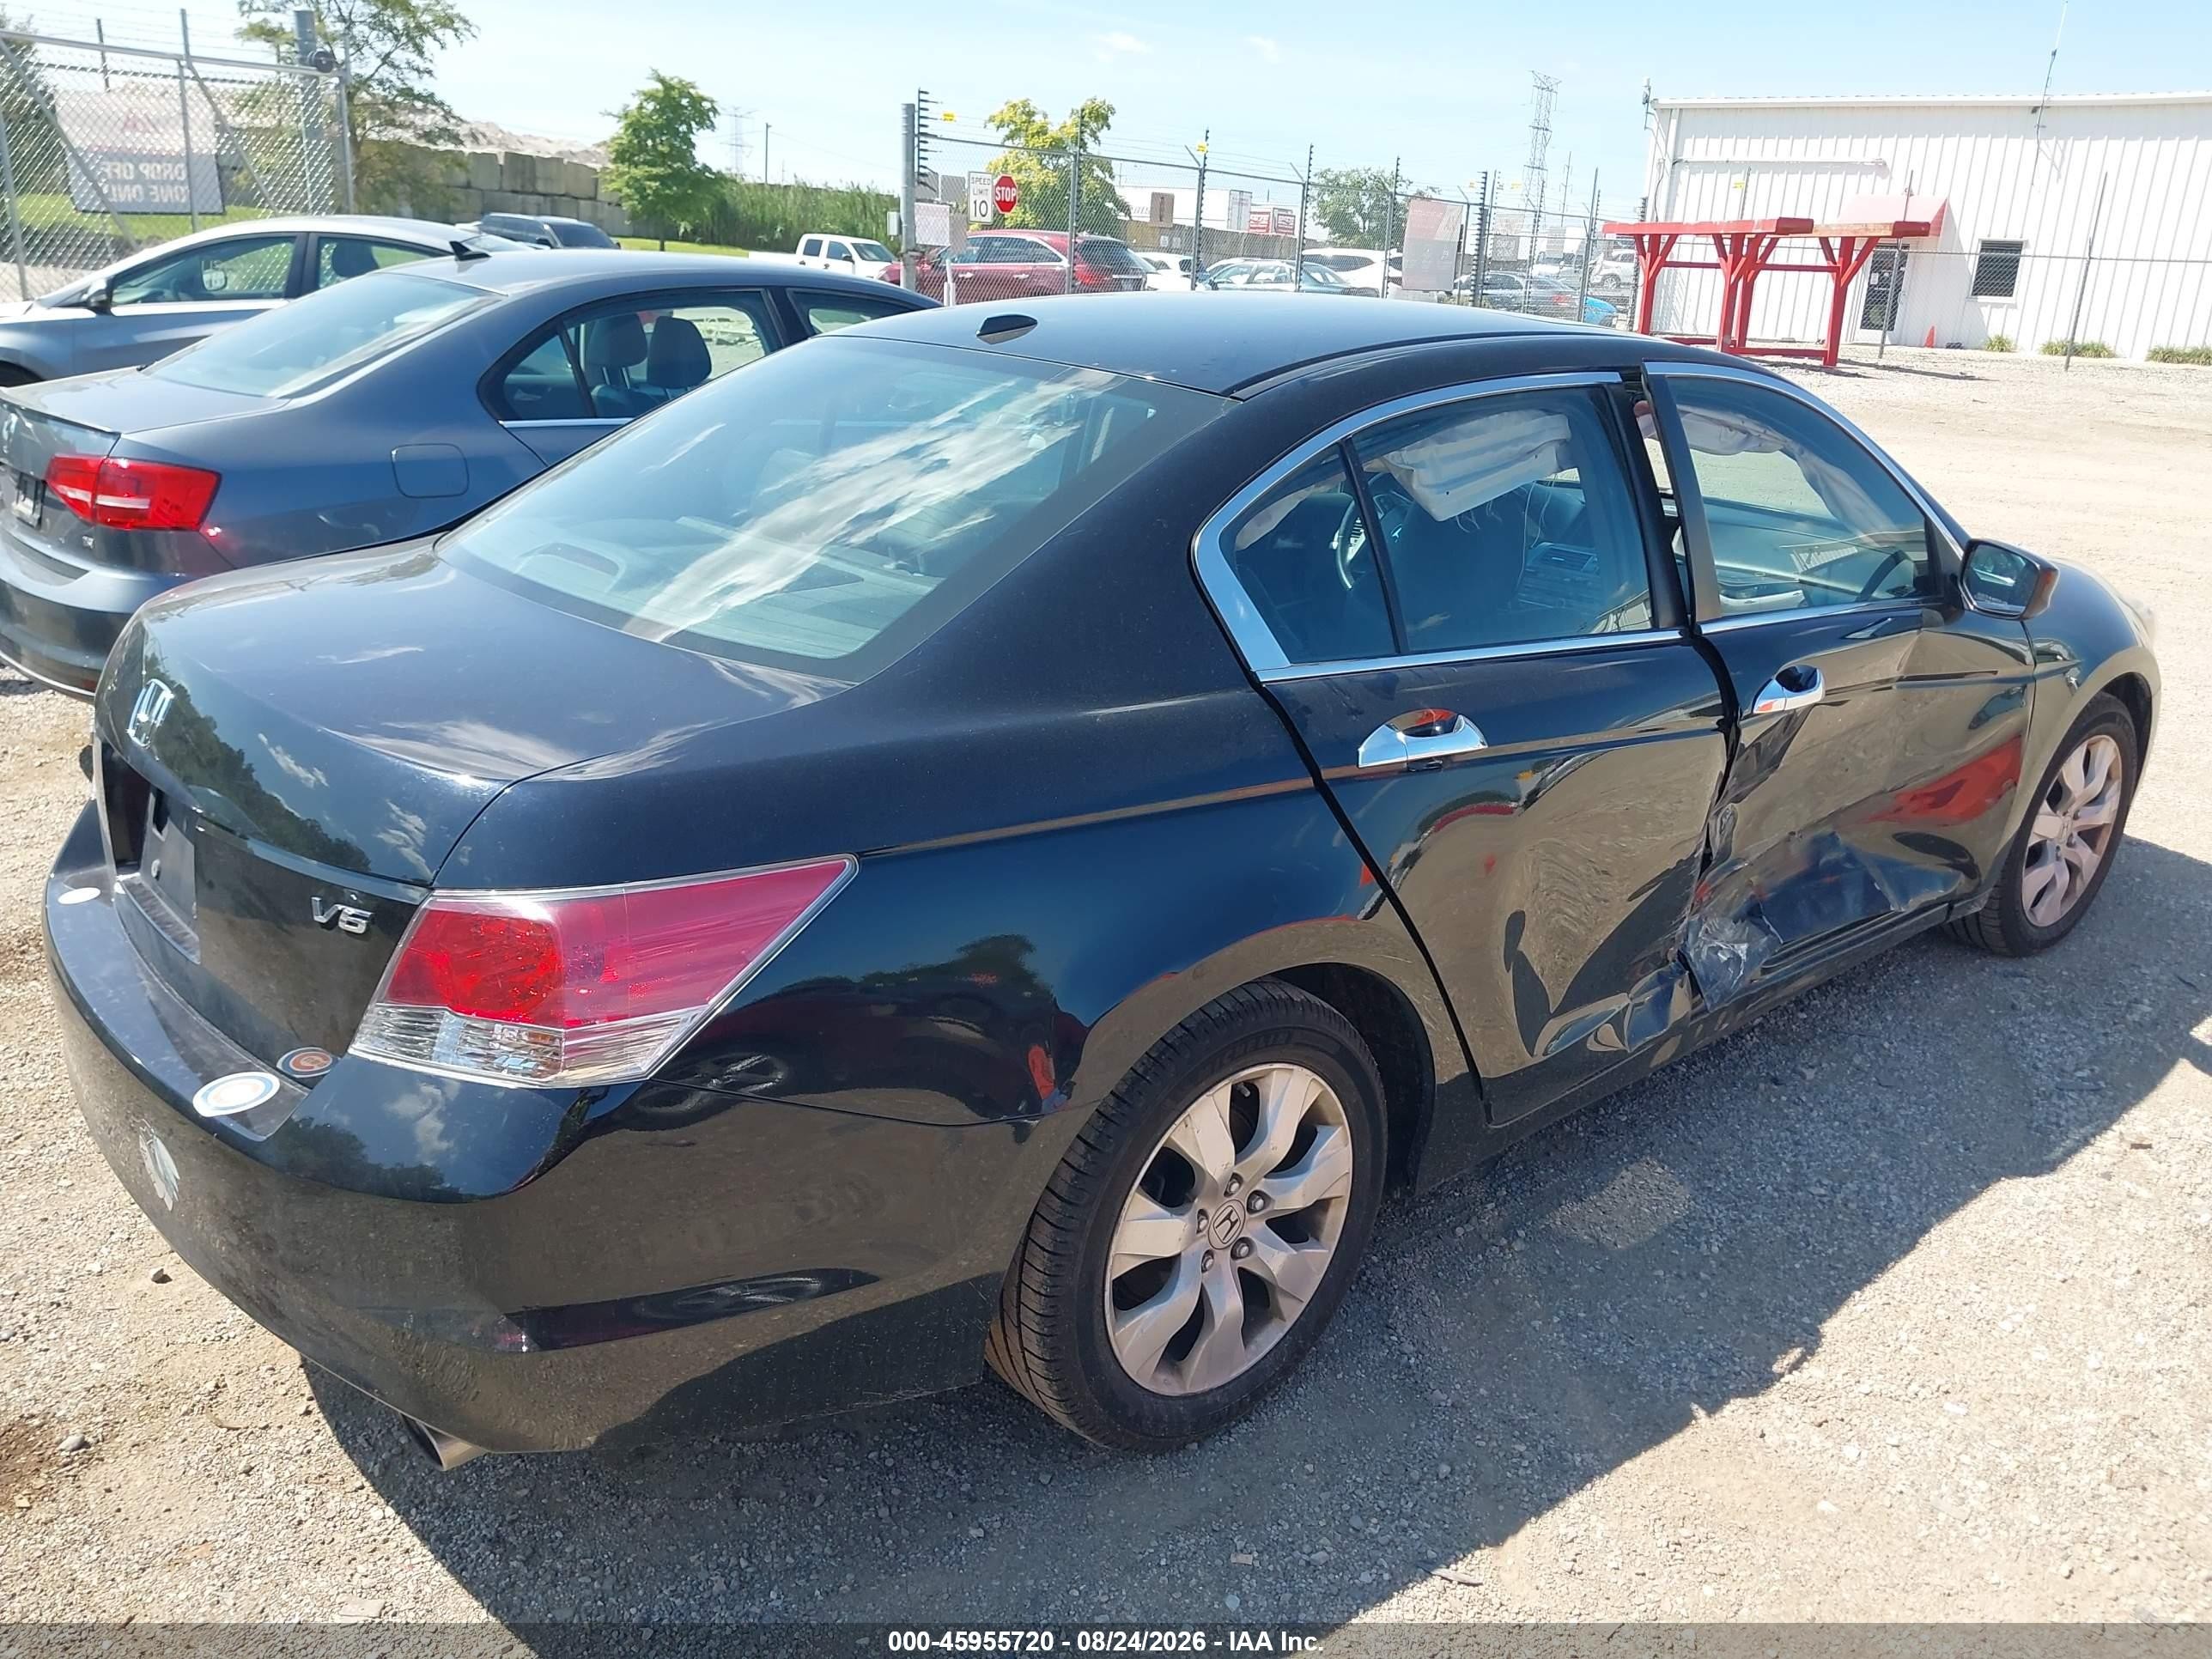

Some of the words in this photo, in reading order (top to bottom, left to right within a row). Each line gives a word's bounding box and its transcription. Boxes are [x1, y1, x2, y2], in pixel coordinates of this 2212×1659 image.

[971, 176, 991, 185] SPEED
[995, 185, 1017, 202] STOP
[974, 198, 988, 217] 10
[311, 896, 373, 933] V6
